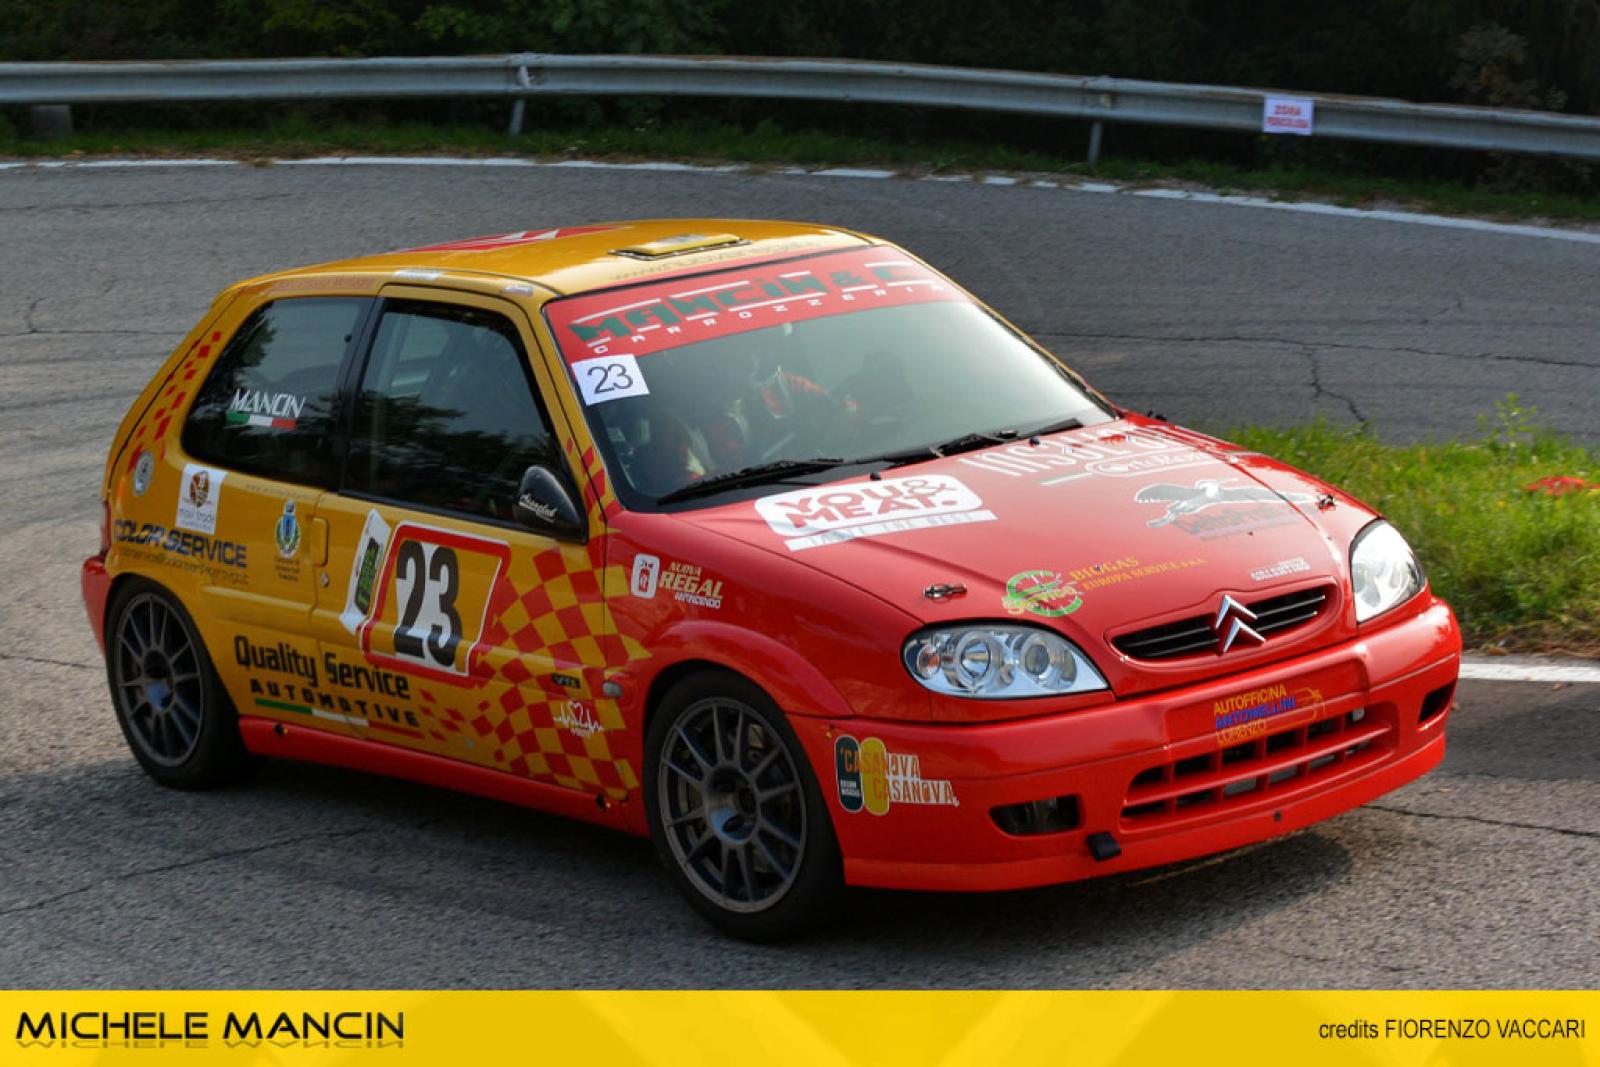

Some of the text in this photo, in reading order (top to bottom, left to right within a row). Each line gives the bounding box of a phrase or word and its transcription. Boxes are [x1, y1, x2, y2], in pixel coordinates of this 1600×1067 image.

[587, 363, 634, 395] 23
[163, 529, 248, 568] SERVICE
[394, 540, 463, 667] 23
[659, 571, 723, 600] REGAL
[234, 635, 412, 700] Quality Service
[250, 678, 420, 728] AUTOMOTIVE
[1214, 684, 1287, 716] AUTOFFICINA
